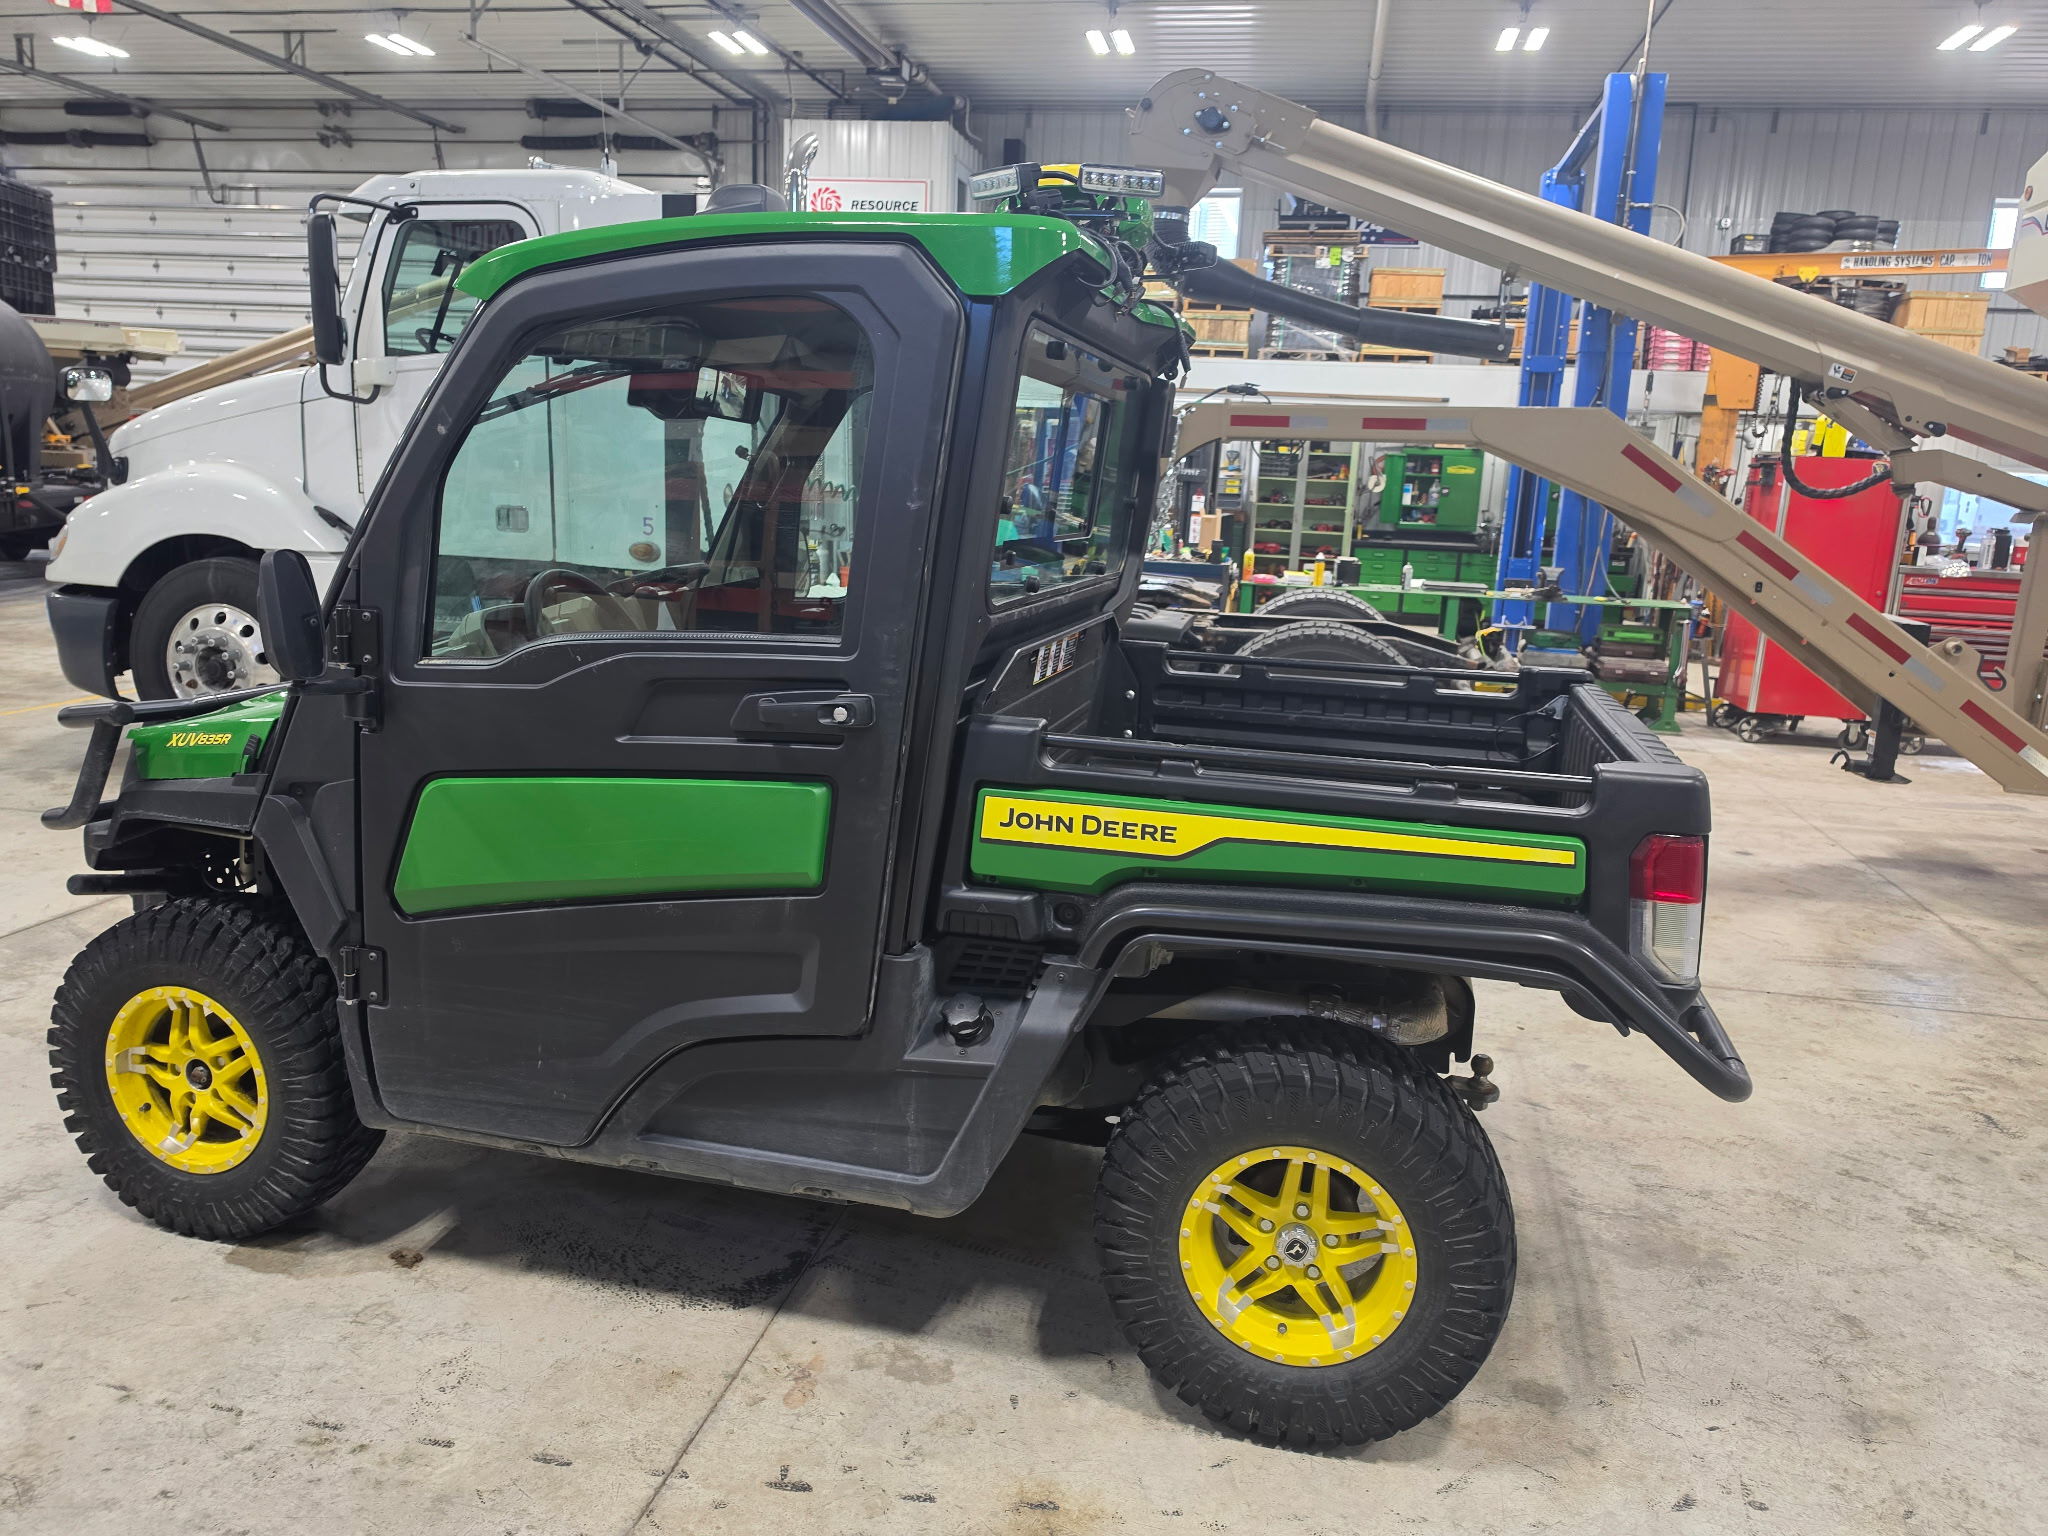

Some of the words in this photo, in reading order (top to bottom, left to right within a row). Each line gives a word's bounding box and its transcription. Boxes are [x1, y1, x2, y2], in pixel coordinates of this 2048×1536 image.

[821, 197, 833, 210] LG
[851, 200, 919, 212] RESOURCE
[1853, 255, 1891, 267] HANDLING
[1894, 255, 1934, 267] SYSTEMS
[1978, 252, 1992, 266] TON
[642, 517, 654, 536] 5
[166, 732, 232, 747] XUV835R
[999, 807, 1074, 833] JOHN
[1081, 814, 1178, 844] DEERE
